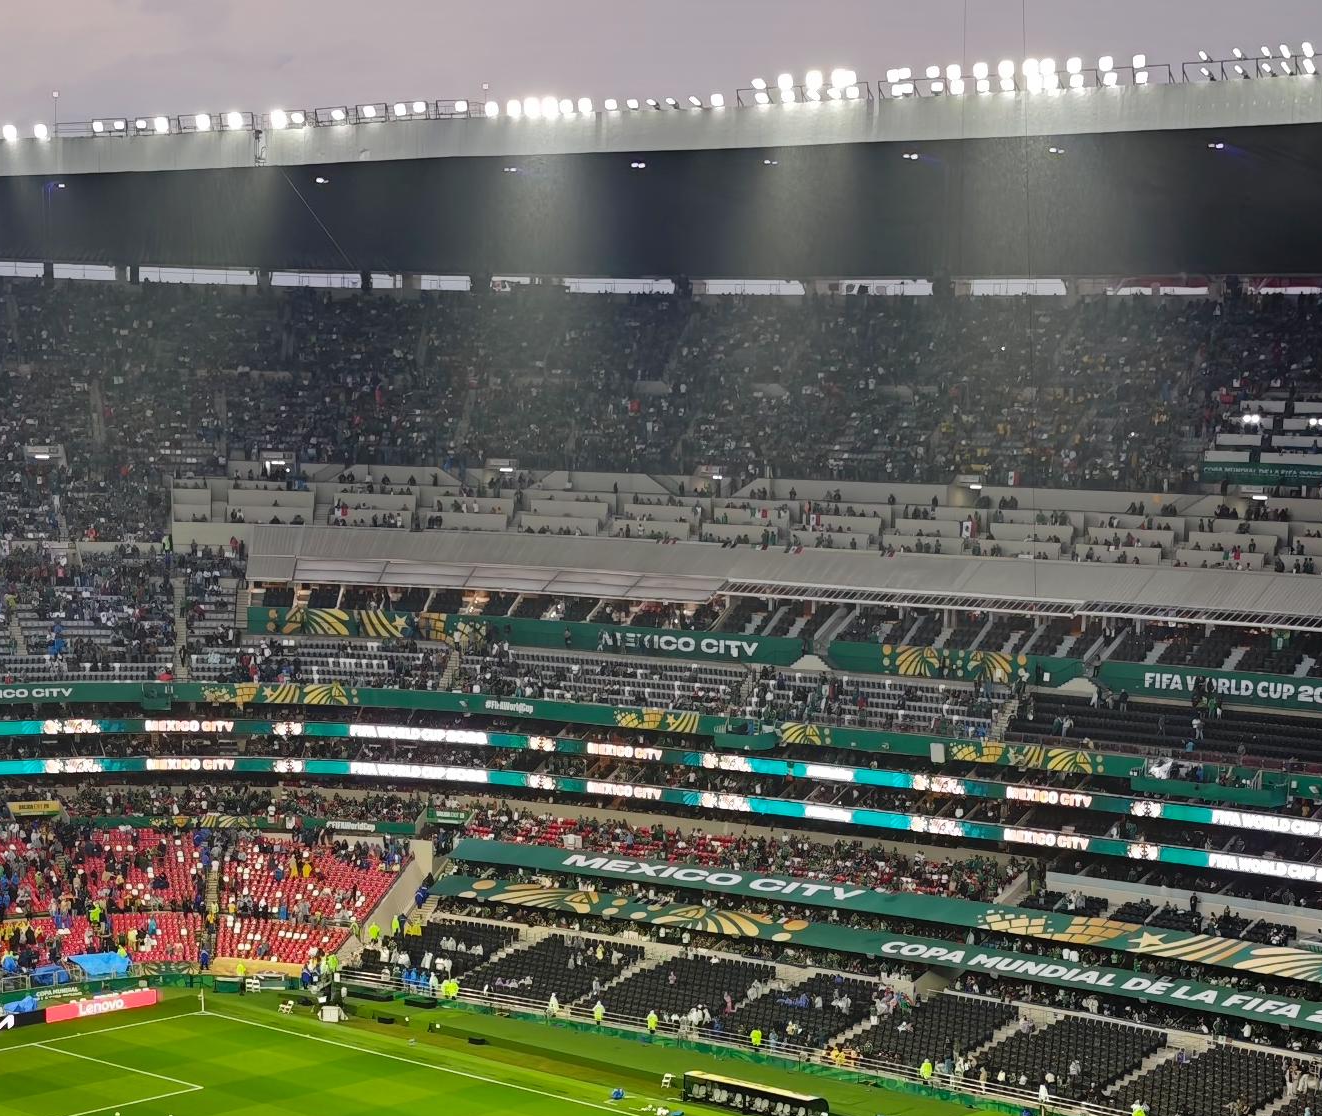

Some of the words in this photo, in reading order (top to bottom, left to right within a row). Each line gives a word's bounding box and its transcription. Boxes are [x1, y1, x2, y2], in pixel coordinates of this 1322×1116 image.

[701, 638, 758, 657] CITY
[32, 687, 74, 699] CITY
[1144, 672, 1182, 691] FIFA
[1257, 681, 1295, 700] CUP
[561, 854, 743, 886] MEXICO
[747, 876, 870, 901] CITY
[880, 941, 969, 966] COPA
[973, 953, 1119, 988] MUNDIAL
[1125, 976, 1172, 995] DE
[1171, 984, 1219, 1003] LA
[1220, 992, 1302, 1018] FIFA
[79, 998, 124, 1016] Lenovo
